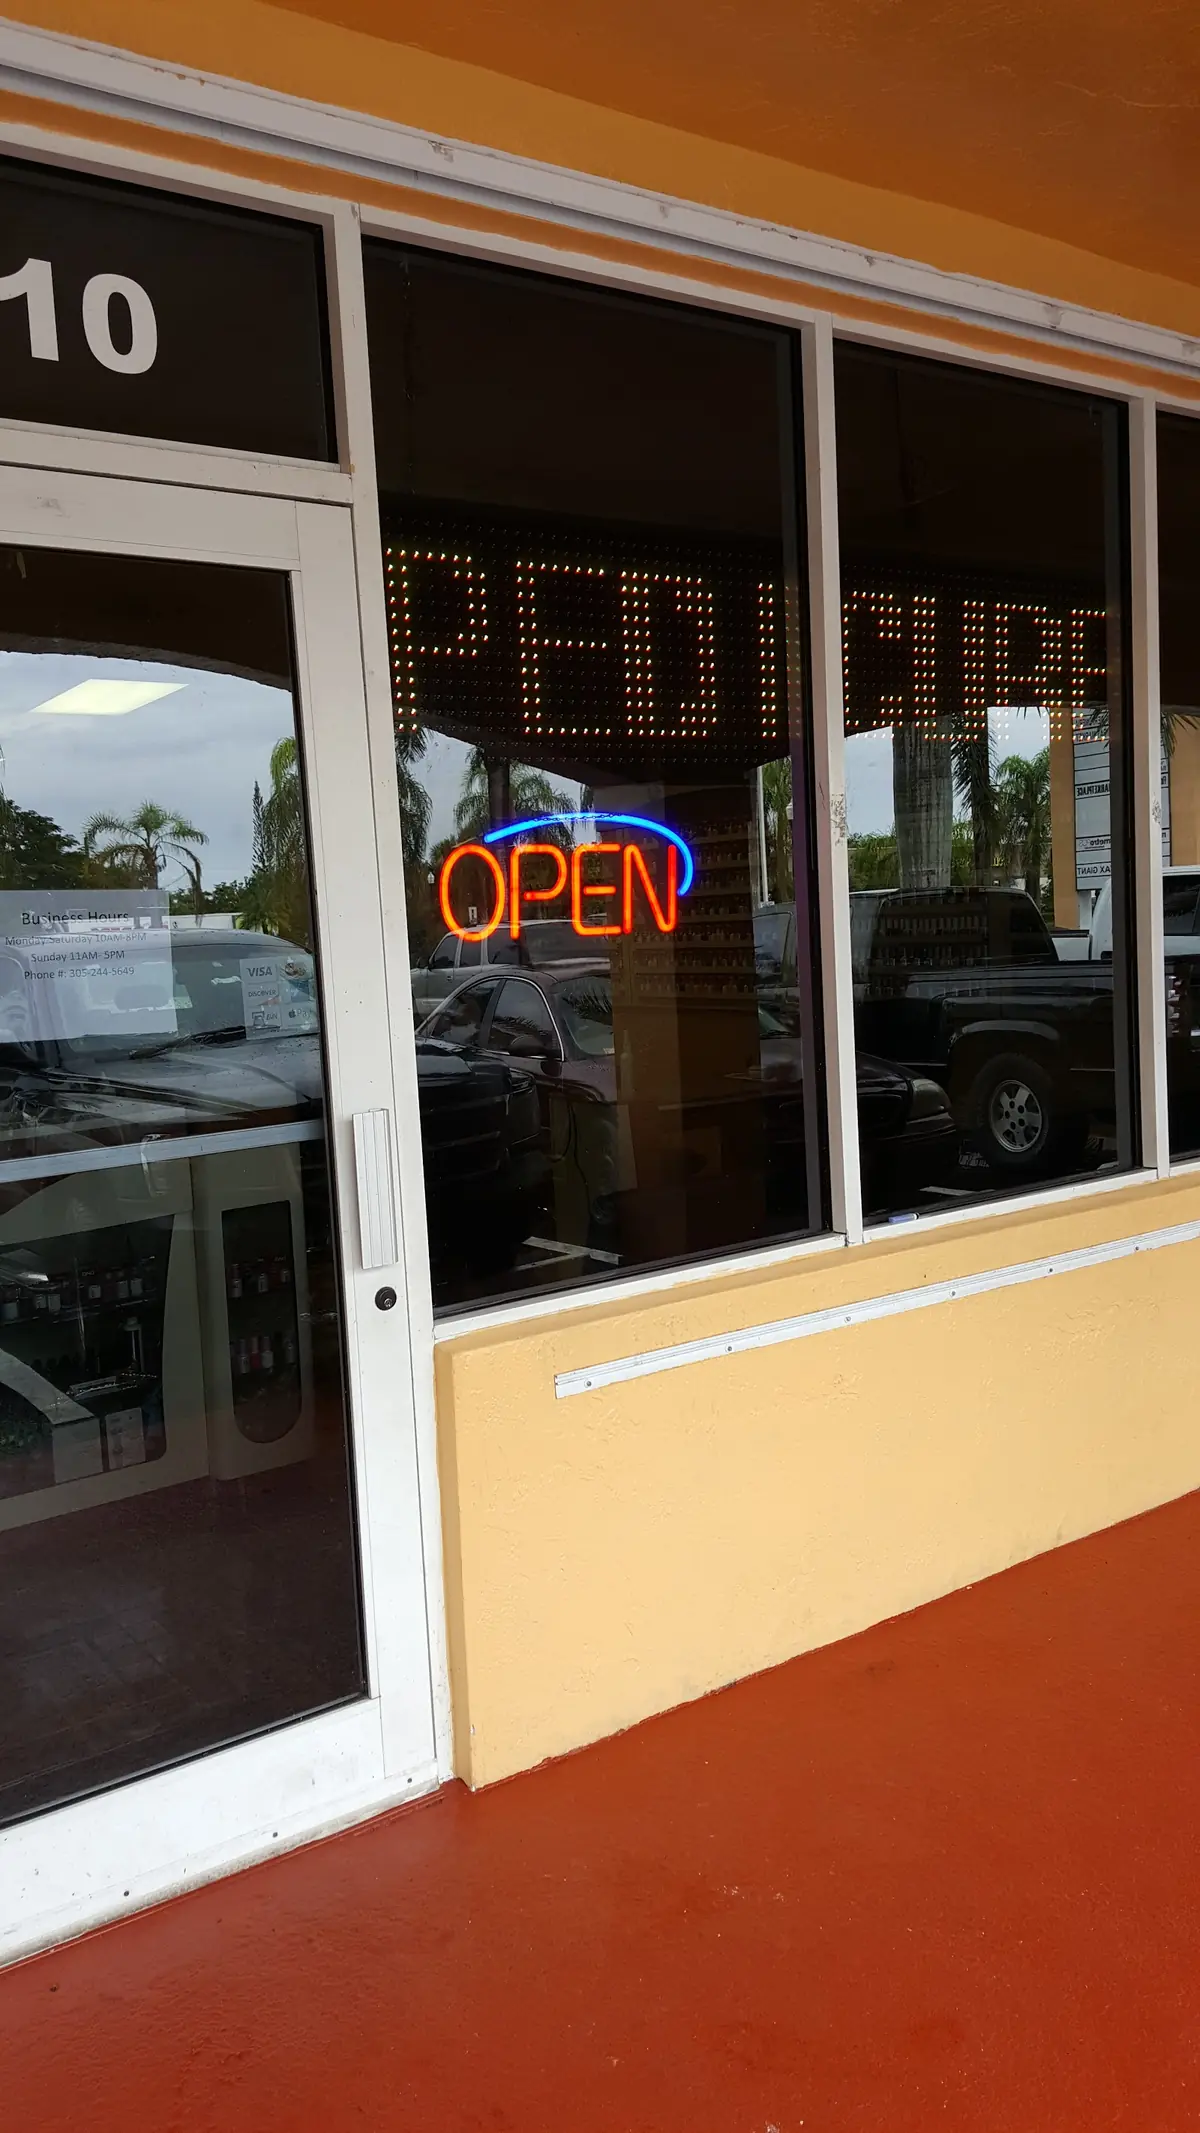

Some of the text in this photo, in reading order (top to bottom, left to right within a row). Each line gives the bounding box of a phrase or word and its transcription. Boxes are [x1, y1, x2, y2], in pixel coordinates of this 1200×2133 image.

[0, 257, 158, 375] 10
[439, 842, 678, 942] OPEN
[22, 911, 129, 925] Business Hours
[31, 951, 67, 963] Sunday
[24, 969, 55, 980] Phone
[70, 966, 135, 978] 305-244-5649
[246, 966, 273, 977] VISA
[248, 988, 277, 998] DISCOVER
